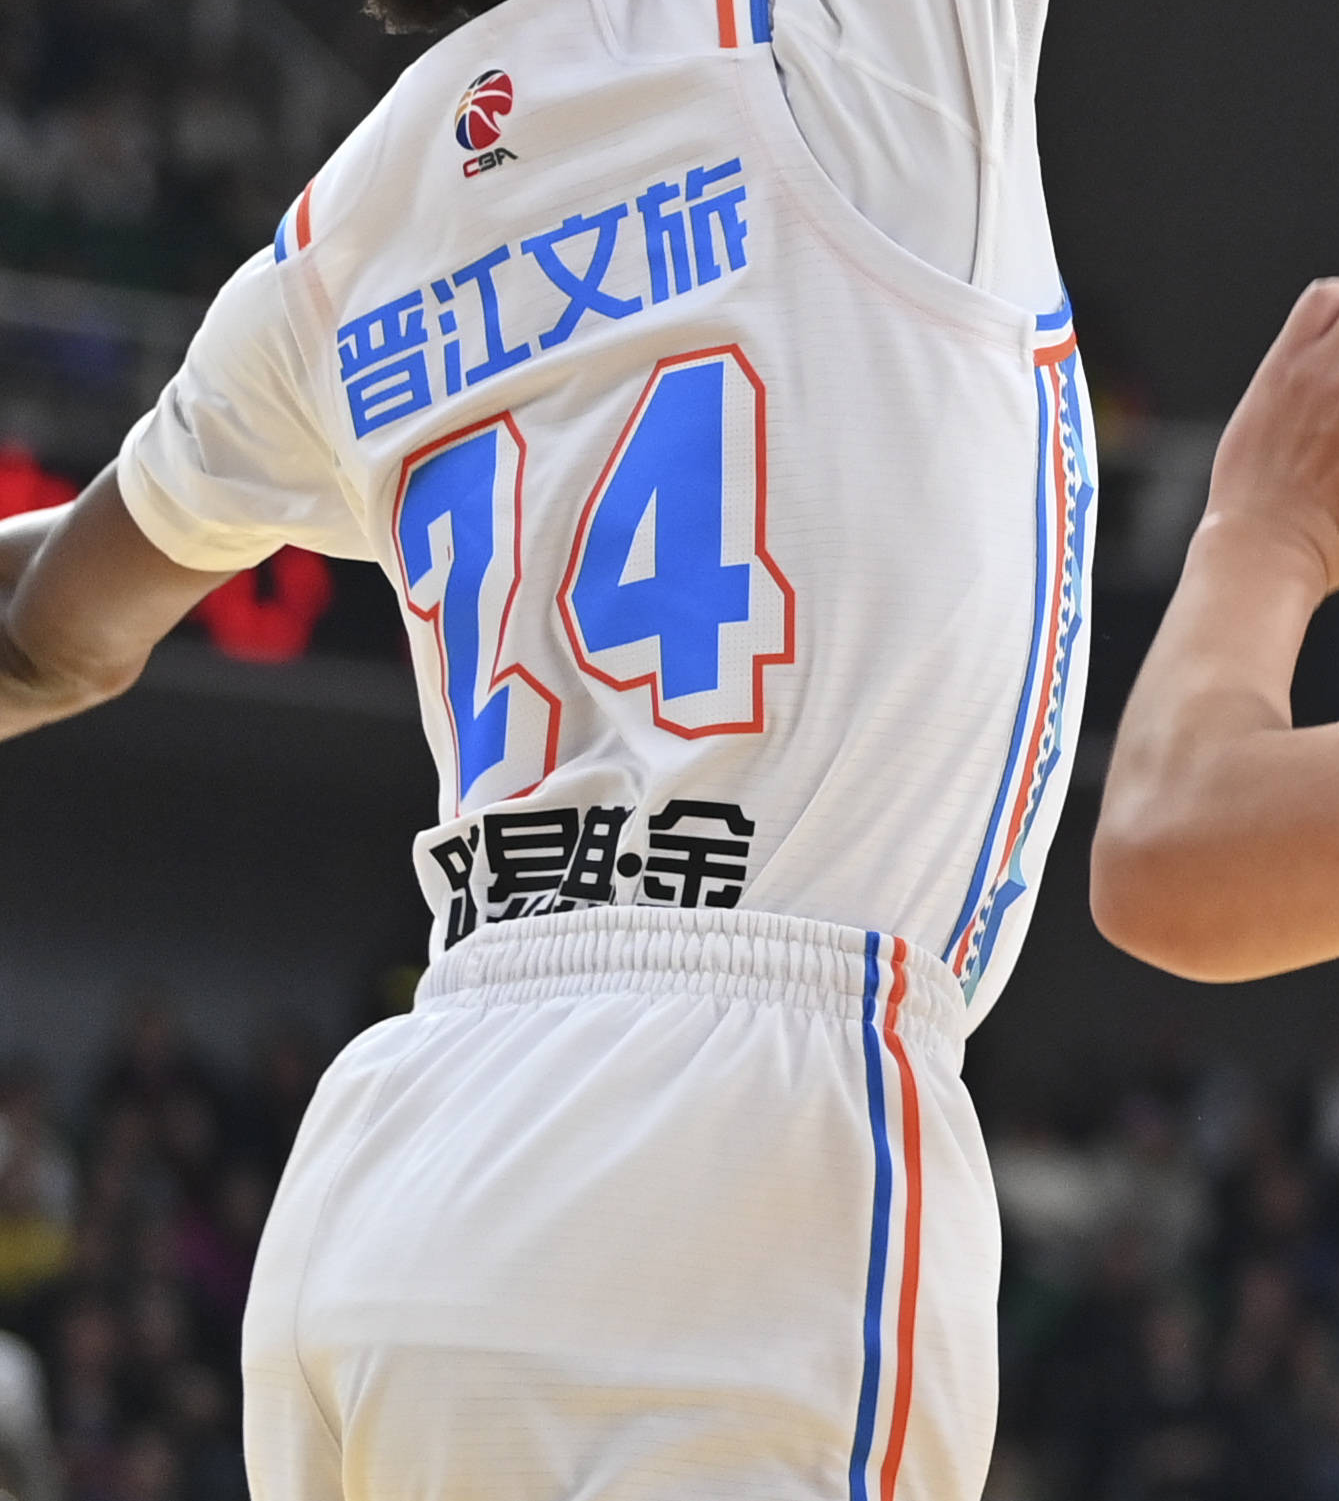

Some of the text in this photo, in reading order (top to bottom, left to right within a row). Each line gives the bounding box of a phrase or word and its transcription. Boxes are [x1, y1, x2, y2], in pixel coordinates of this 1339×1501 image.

[335, 159, 747, 439] 晋江文旅
[463, 147, 519, 179] CBA
[391, 344, 795, 816] 24
